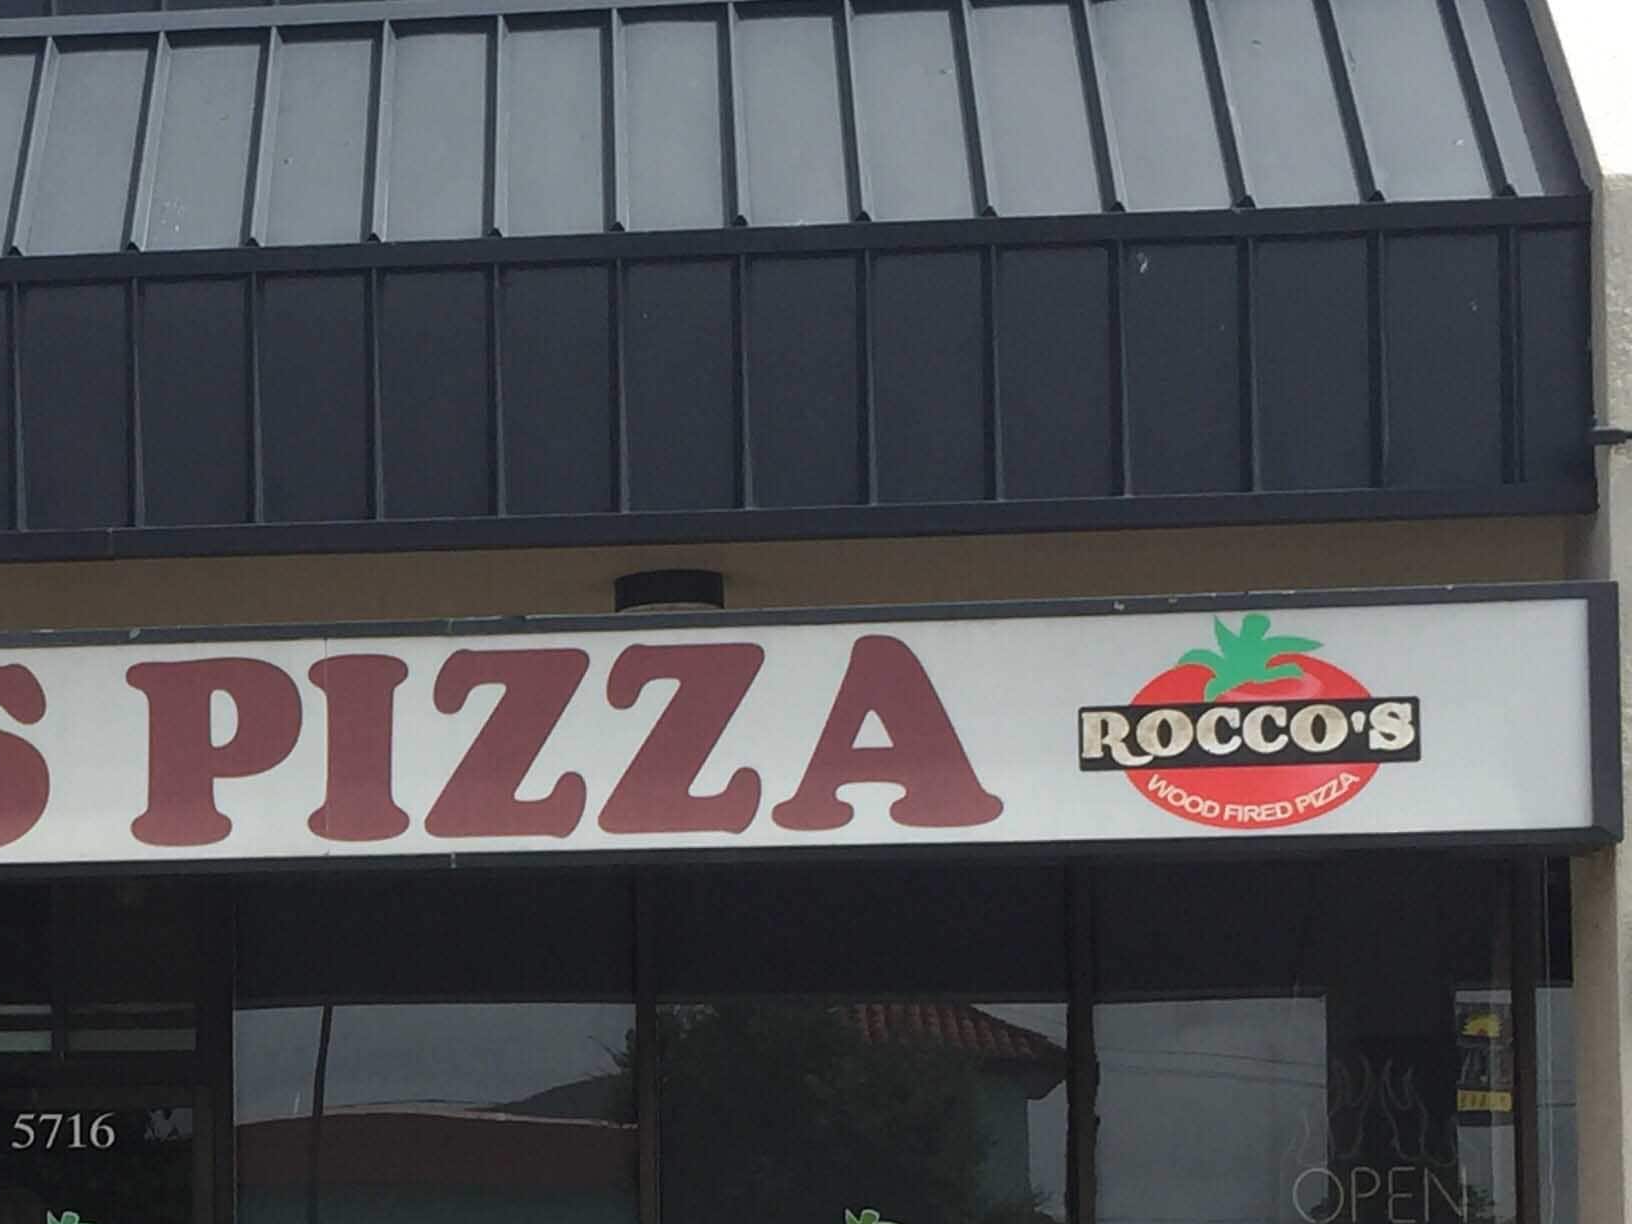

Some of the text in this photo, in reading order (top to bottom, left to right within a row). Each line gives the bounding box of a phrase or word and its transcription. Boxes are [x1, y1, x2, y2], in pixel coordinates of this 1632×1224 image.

[126, 634, 1004, 847] PIZZA
[1080, 702, 1416, 767] ROCCO'S
[1147, 771, 1361, 823] WOOD FIRED PIZZA
[11, 1112, 115, 1149] 5716
[1292, 1166, 1469, 1224] OPEN
